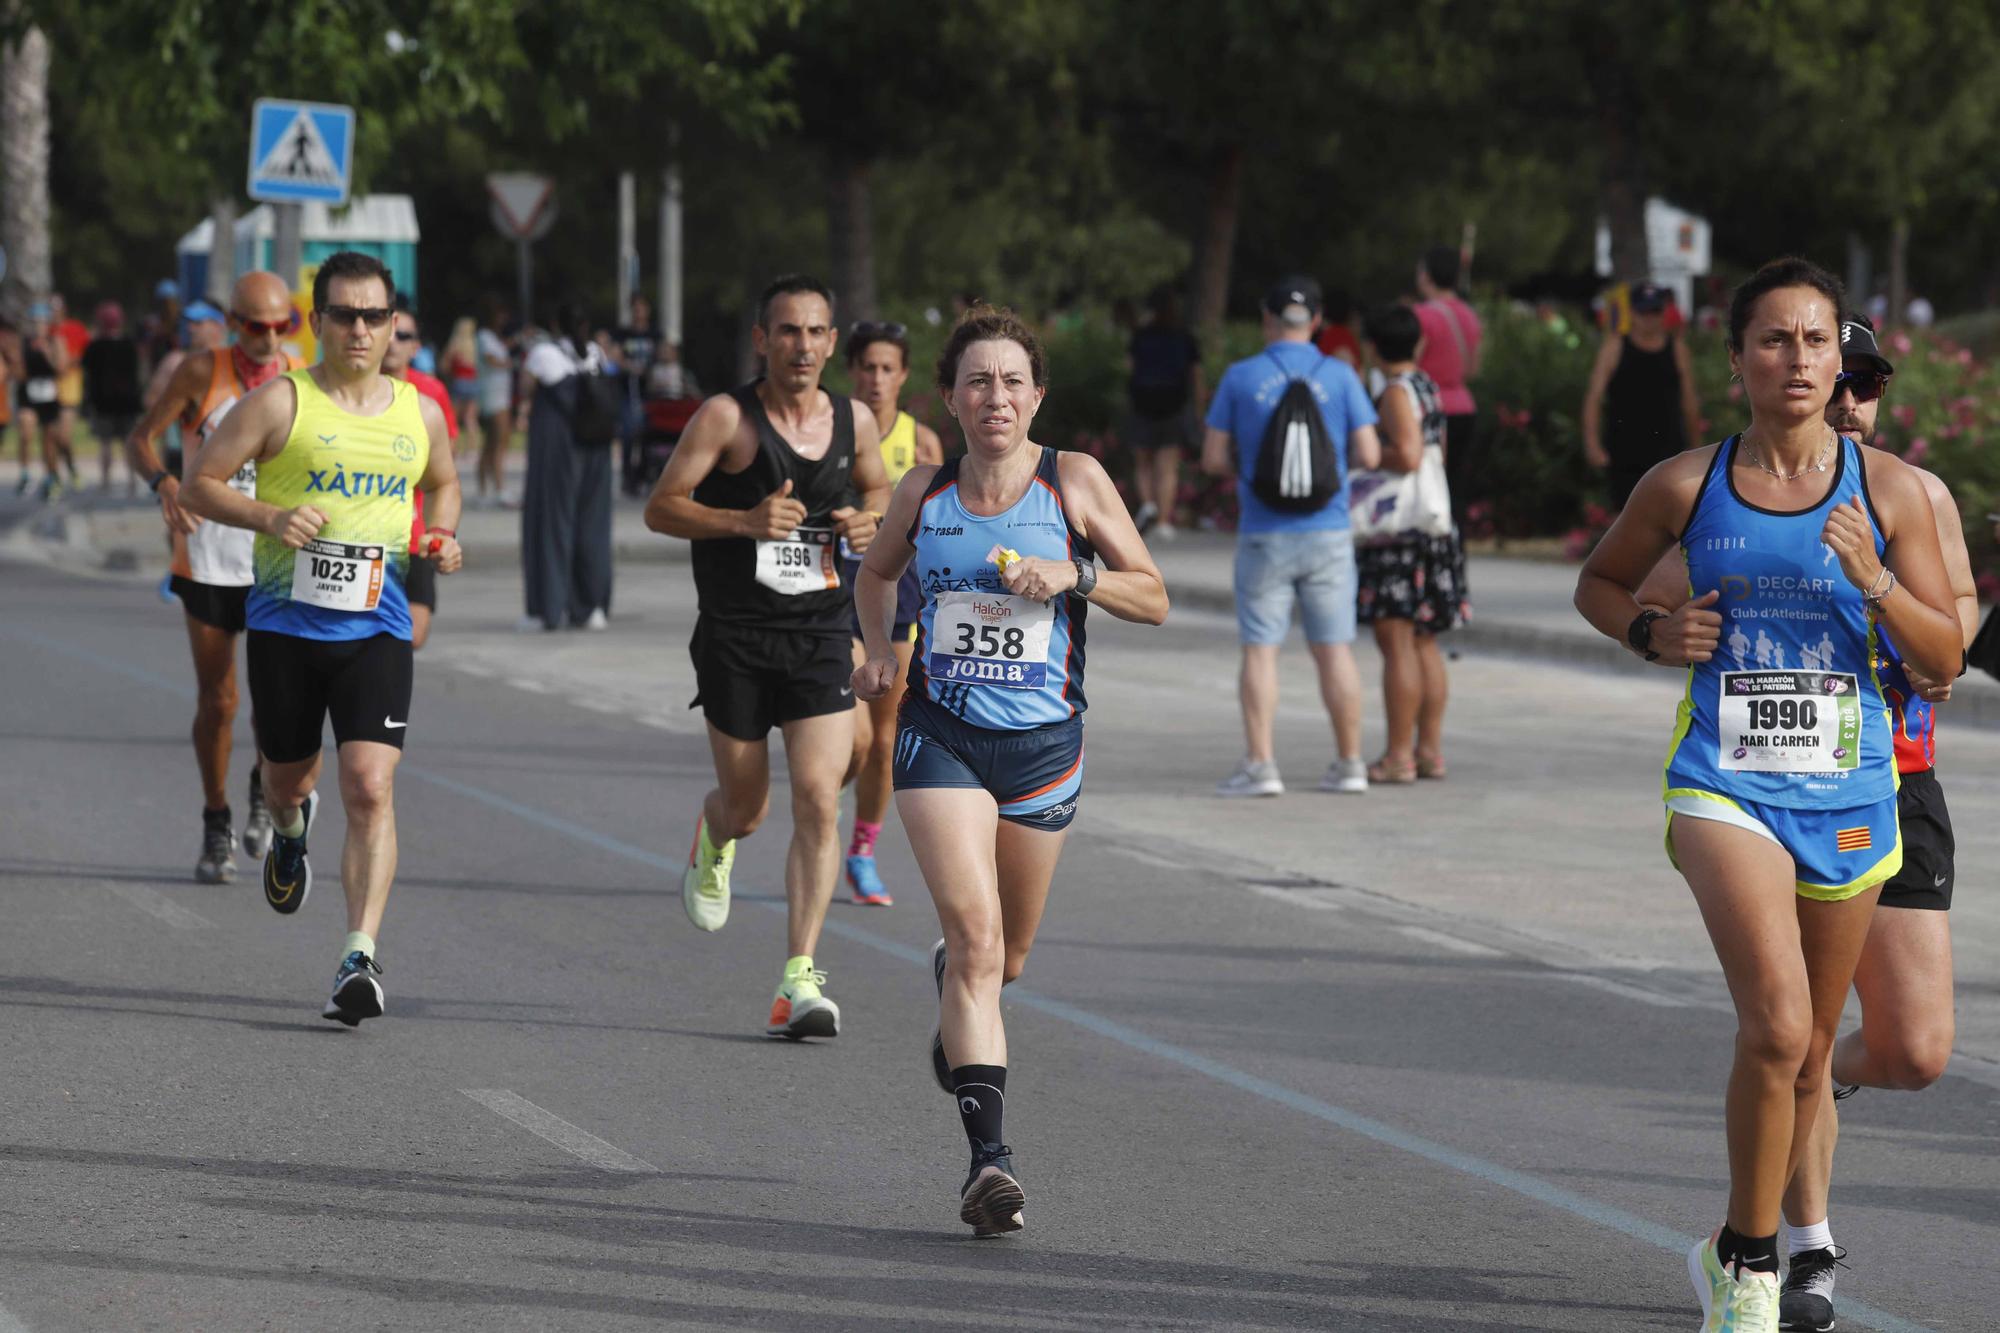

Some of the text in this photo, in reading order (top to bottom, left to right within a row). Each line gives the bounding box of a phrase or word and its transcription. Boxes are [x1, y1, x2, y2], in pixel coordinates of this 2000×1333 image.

[305, 462, 406, 503] XÀTIVA
[935, 524, 964, 536] rasán
[1707, 536, 1746, 551] GOBIK
[311, 556, 358, 582] 1023
[315, 582, 343, 593] JAVIER
[1758, 576, 1835, 593] DECART
[1759, 591, 1832, 602] PROPERTY
[1731, 608, 1828, 620] Club d'Atletisme
[954, 622, 1024, 660] 358
[1751, 683, 1762, 692] DE
[1763, 682, 1797, 691] PATERNA
[1756, 675, 1795, 685] MARATÓN
[1747, 699, 1818, 730] 1990
[1844, 708, 1855, 729] BOX
[1740, 735, 1820, 748] MARI CARMEN
